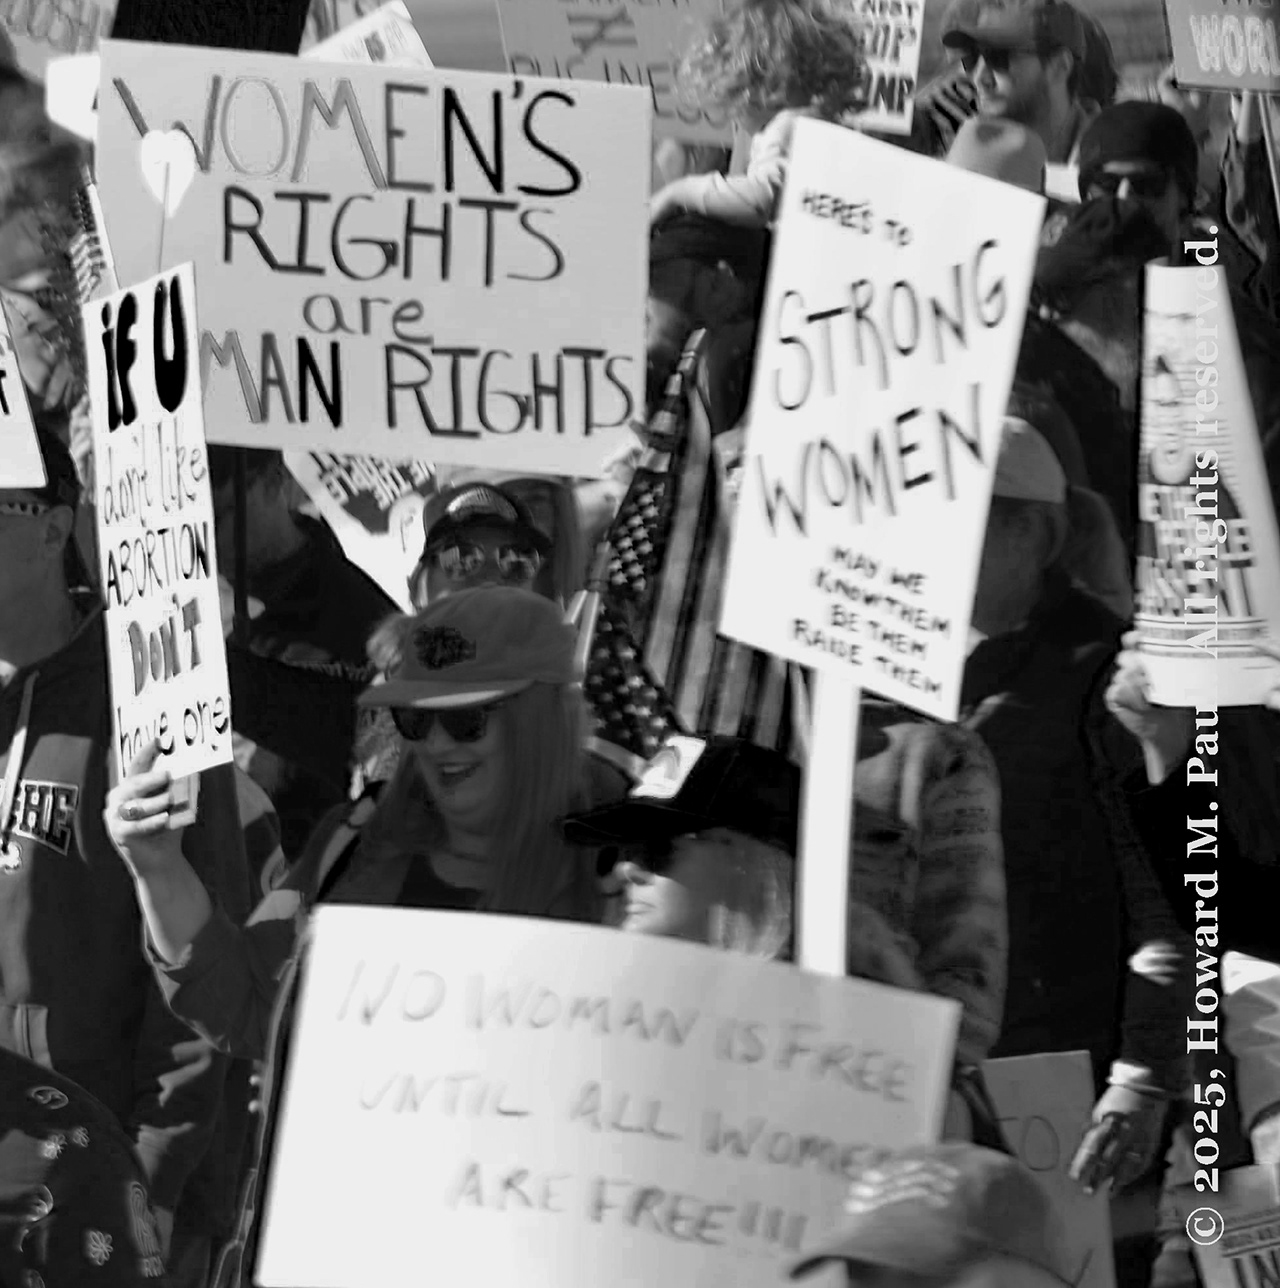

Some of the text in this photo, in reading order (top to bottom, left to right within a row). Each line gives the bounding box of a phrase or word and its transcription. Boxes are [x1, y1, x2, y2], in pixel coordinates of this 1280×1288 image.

[112, 75, 582, 198] WOMEN'S
[224, 183, 566, 288] RIGHTS
[153, 273, 189, 414] U
[303, 293, 435, 345] are
[773, 237, 1009, 411] STRONG
[199, 329, 635, 439] MAN RIGHTS
[156, 415, 209, 514] like
[754, 381, 990, 539] WOMEN
[105, 520, 212, 610] ABORTION
[832, 545, 880, 580] MAY
[830, 603, 860, 633] BE
[872, 655, 942, 701] THEM
[117, 694, 230, 783] have one
[336, 960, 920, 1103] NO WOMAN IS FREE
[358, 1071, 535, 1119] UNTIL
[568, 1081, 686, 1142] ALL
[445, 1160, 564, 1215] ARE
